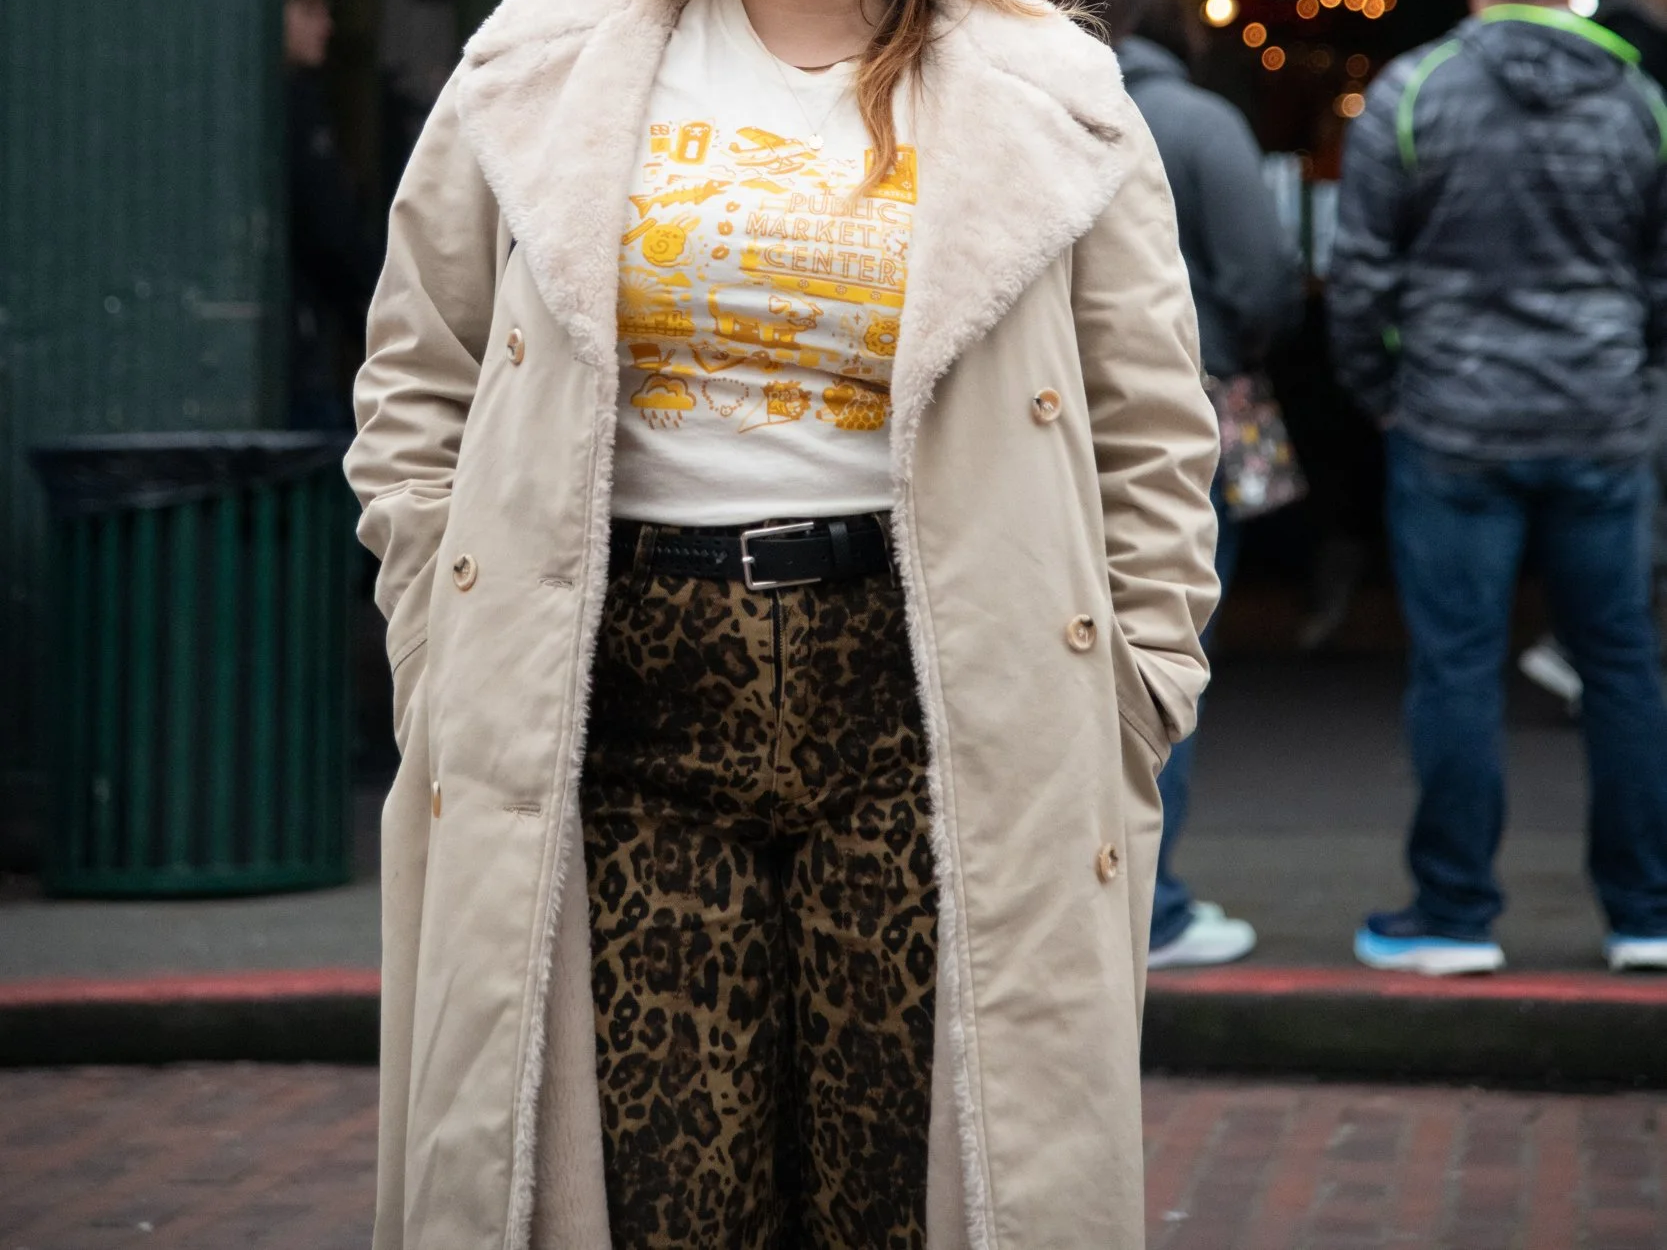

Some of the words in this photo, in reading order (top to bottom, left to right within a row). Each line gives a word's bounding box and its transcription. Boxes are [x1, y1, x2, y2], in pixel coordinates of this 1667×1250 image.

[787, 191, 898, 224] PUBLIC
[745, 211, 876, 248] MARKET
[763, 243, 897, 286] CENTER
